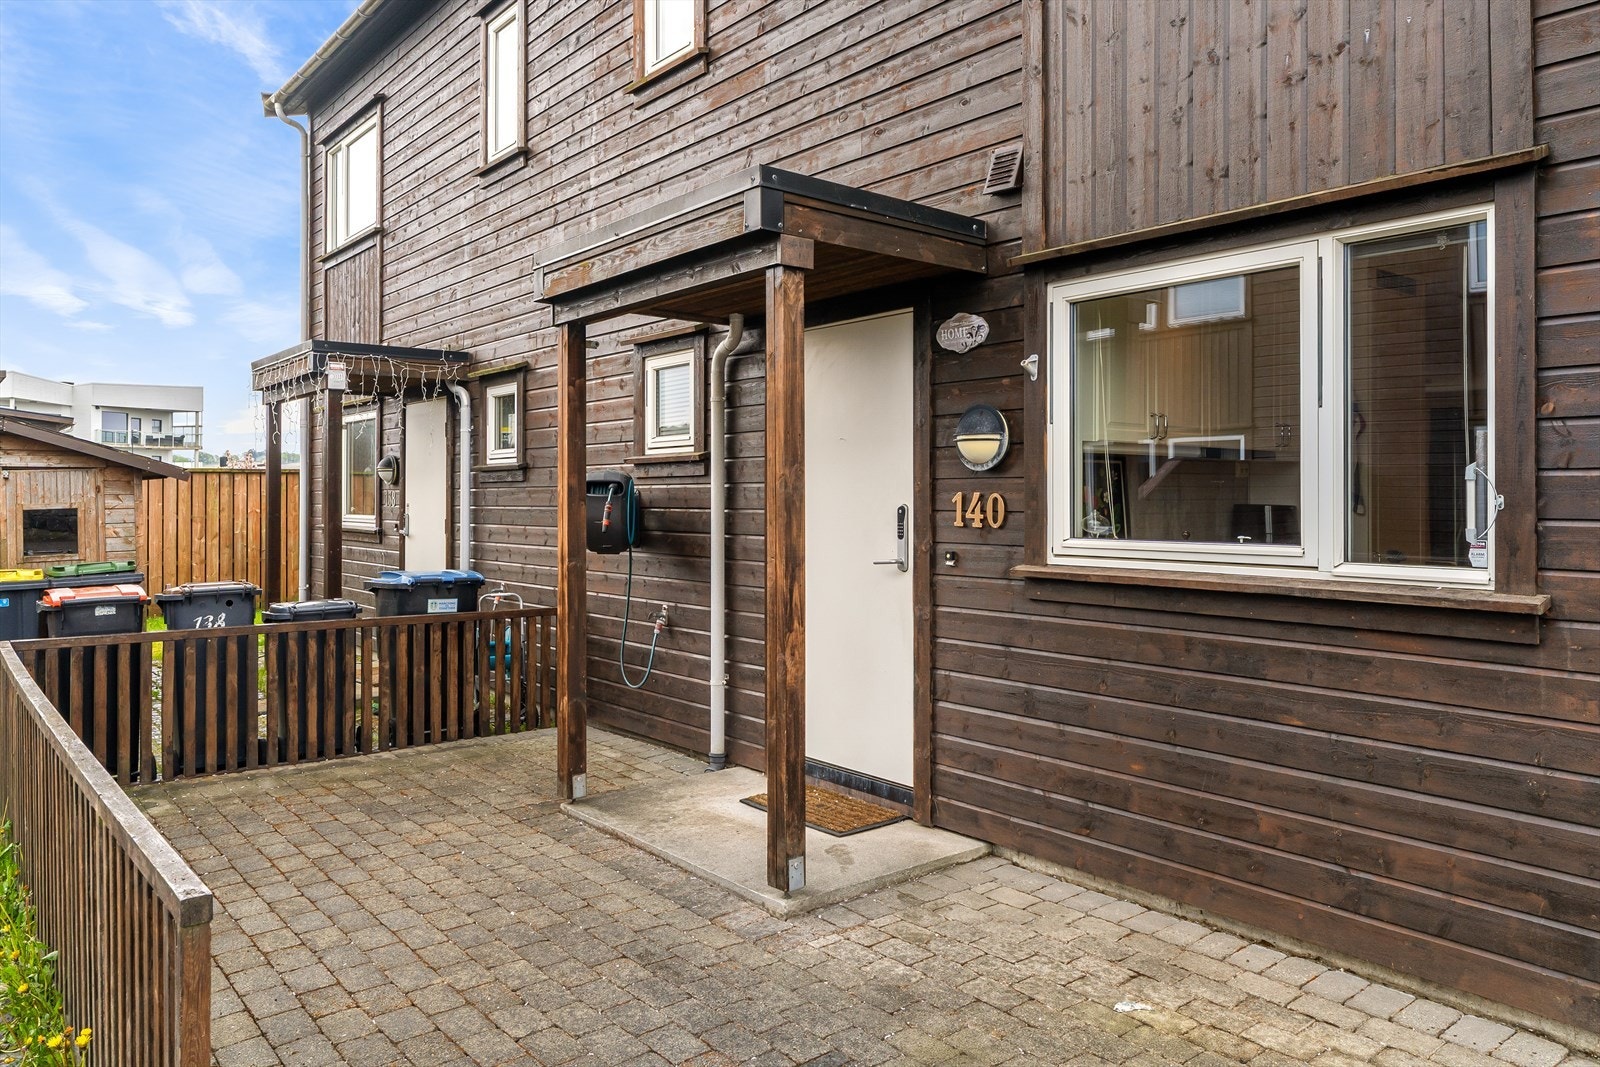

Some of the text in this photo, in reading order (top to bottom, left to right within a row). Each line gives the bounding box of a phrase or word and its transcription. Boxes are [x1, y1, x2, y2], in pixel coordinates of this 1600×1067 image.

[941, 327, 969, 341] HOME
[952, 491, 1005, 529] 140
[193, 612, 226, 629] 138
